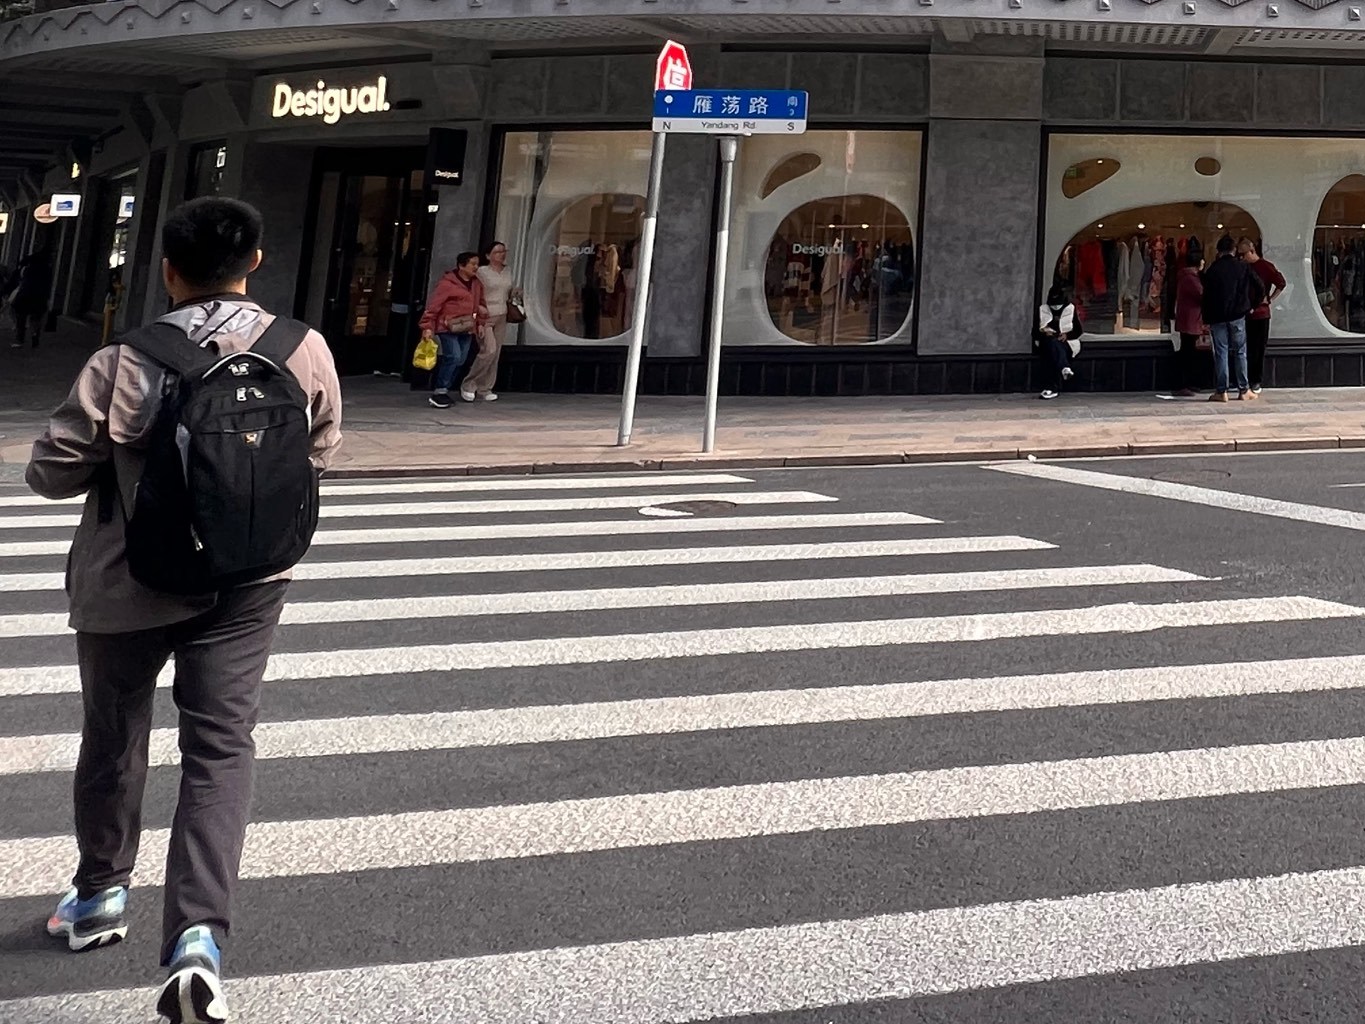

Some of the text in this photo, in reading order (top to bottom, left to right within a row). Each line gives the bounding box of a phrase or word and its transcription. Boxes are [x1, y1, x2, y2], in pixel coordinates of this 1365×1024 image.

[692, 95, 769, 115] 雁荡路
[662, 121, 672, 130] N
[701, 121, 756, 130] Yandang Rd
[787, 121, 795, 131] S
